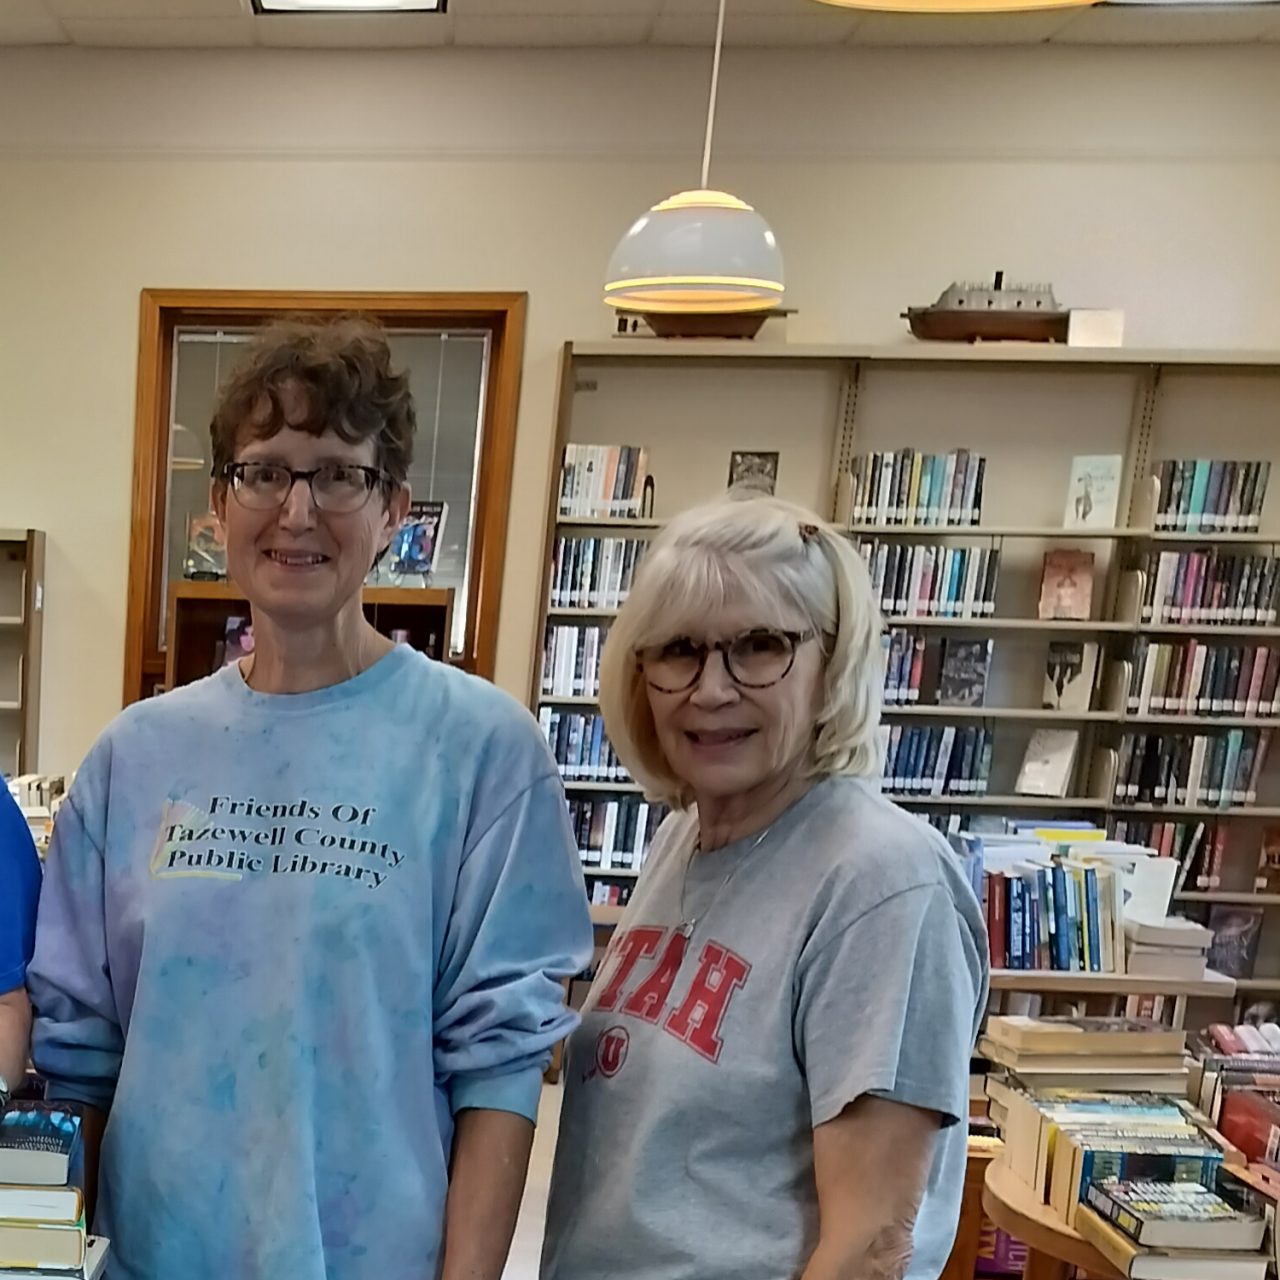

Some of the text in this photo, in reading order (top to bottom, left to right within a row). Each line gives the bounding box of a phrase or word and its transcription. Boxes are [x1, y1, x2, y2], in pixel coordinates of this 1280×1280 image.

[208, 795, 377, 826] Friends Of
[165, 823, 406, 868] Tazewell County
[167, 847, 389, 890] Public Library
[592, 924, 752, 1065] TAH
